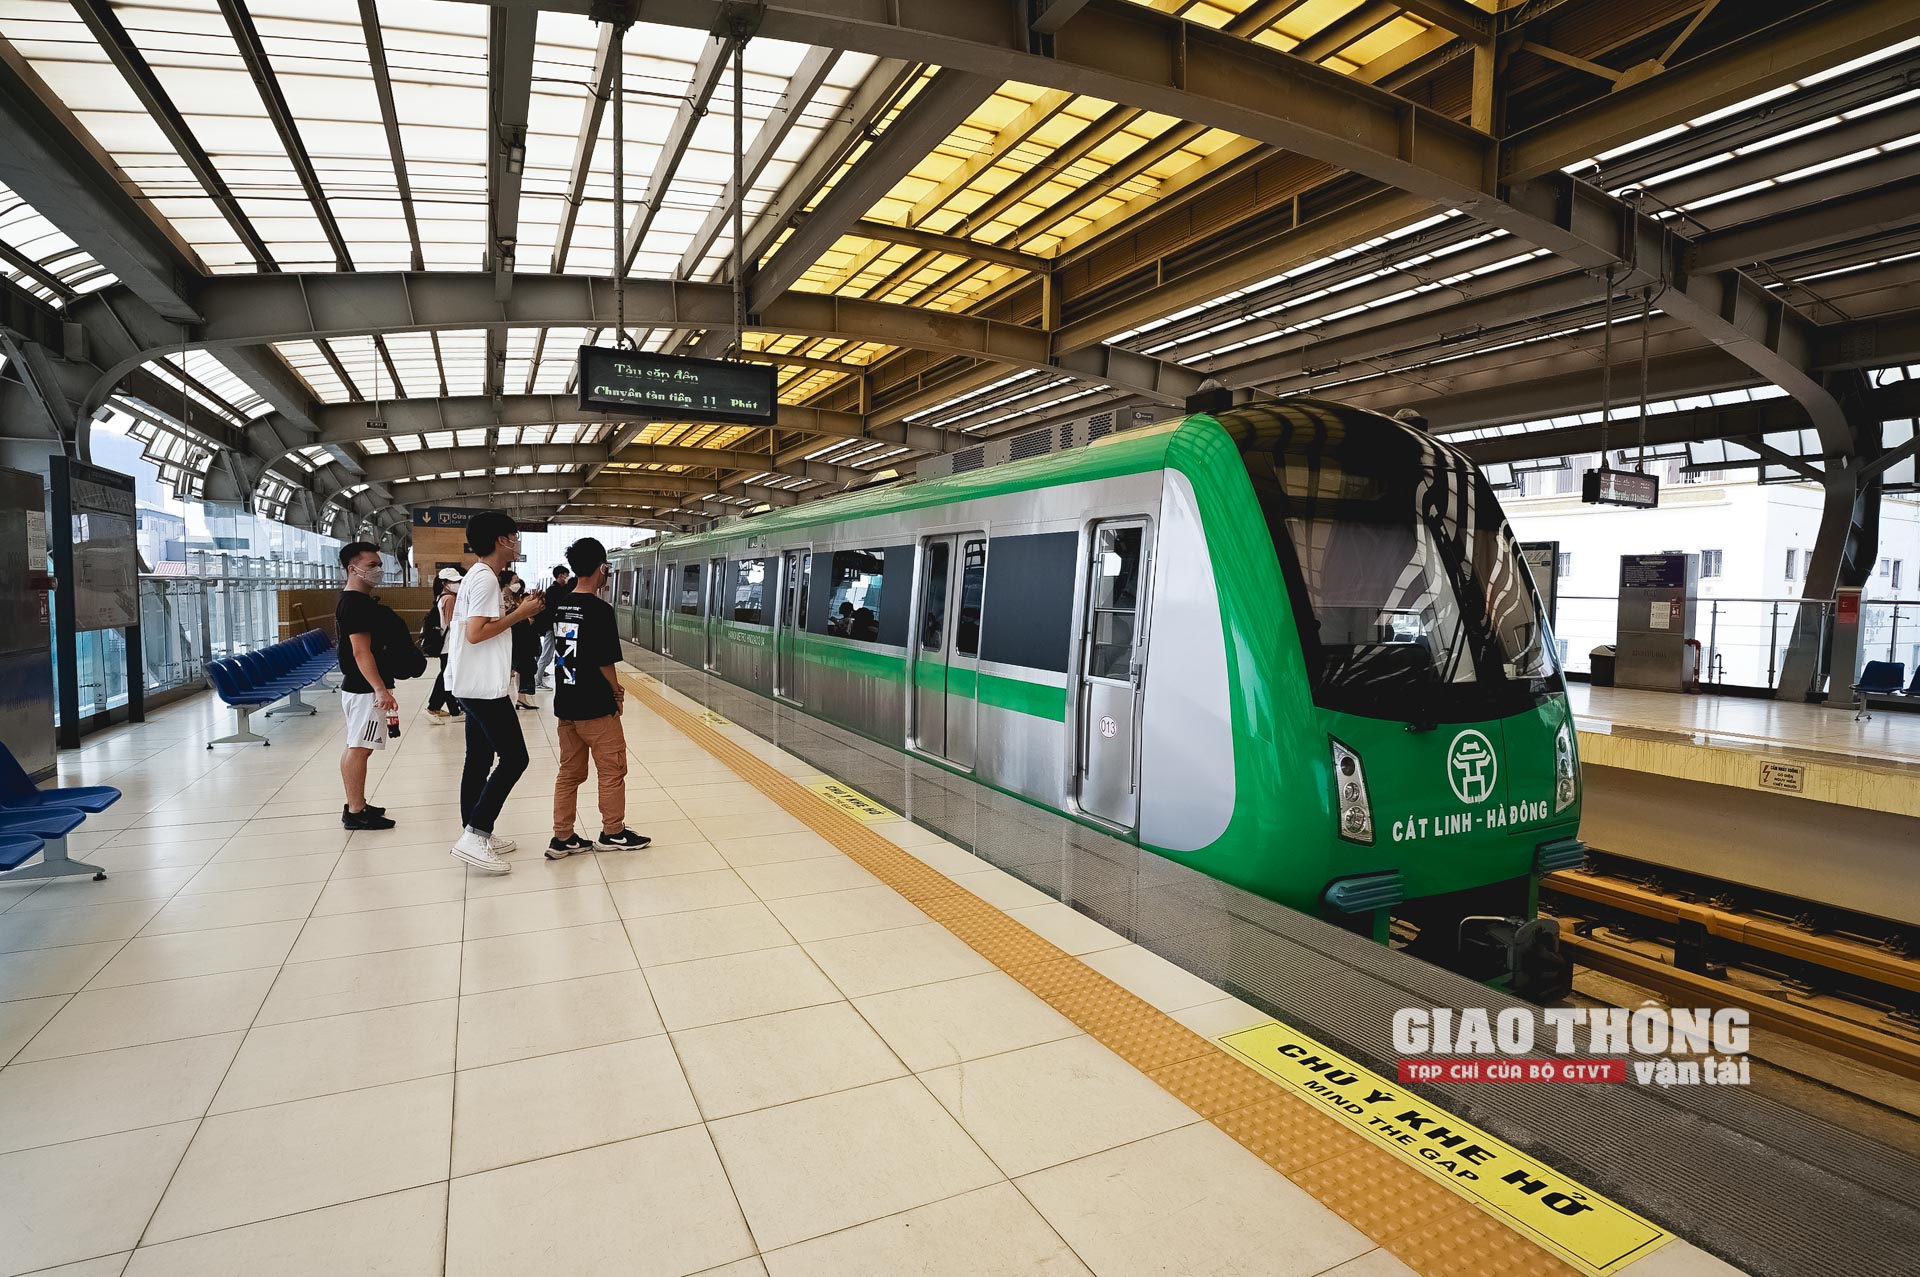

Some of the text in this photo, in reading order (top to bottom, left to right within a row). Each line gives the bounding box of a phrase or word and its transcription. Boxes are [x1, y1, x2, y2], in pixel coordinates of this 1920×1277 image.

[702, 395, 717, 409] 11
[730, 398, 759, 409] Phút
[1101, 719, 1116, 735] 013
[1392, 815, 1428, 842] CÁT
[1434, 812, 1472, 837] LINH
[1487, 803, 1507, 829] HÀ
[1509, 800, 1548, 825] ĐÔNG
[1277, 1043, 1595, 1218] CHÚ Ý KHE HỞ
[1303, 1079, 1481, 1184] MIND THE GAP
